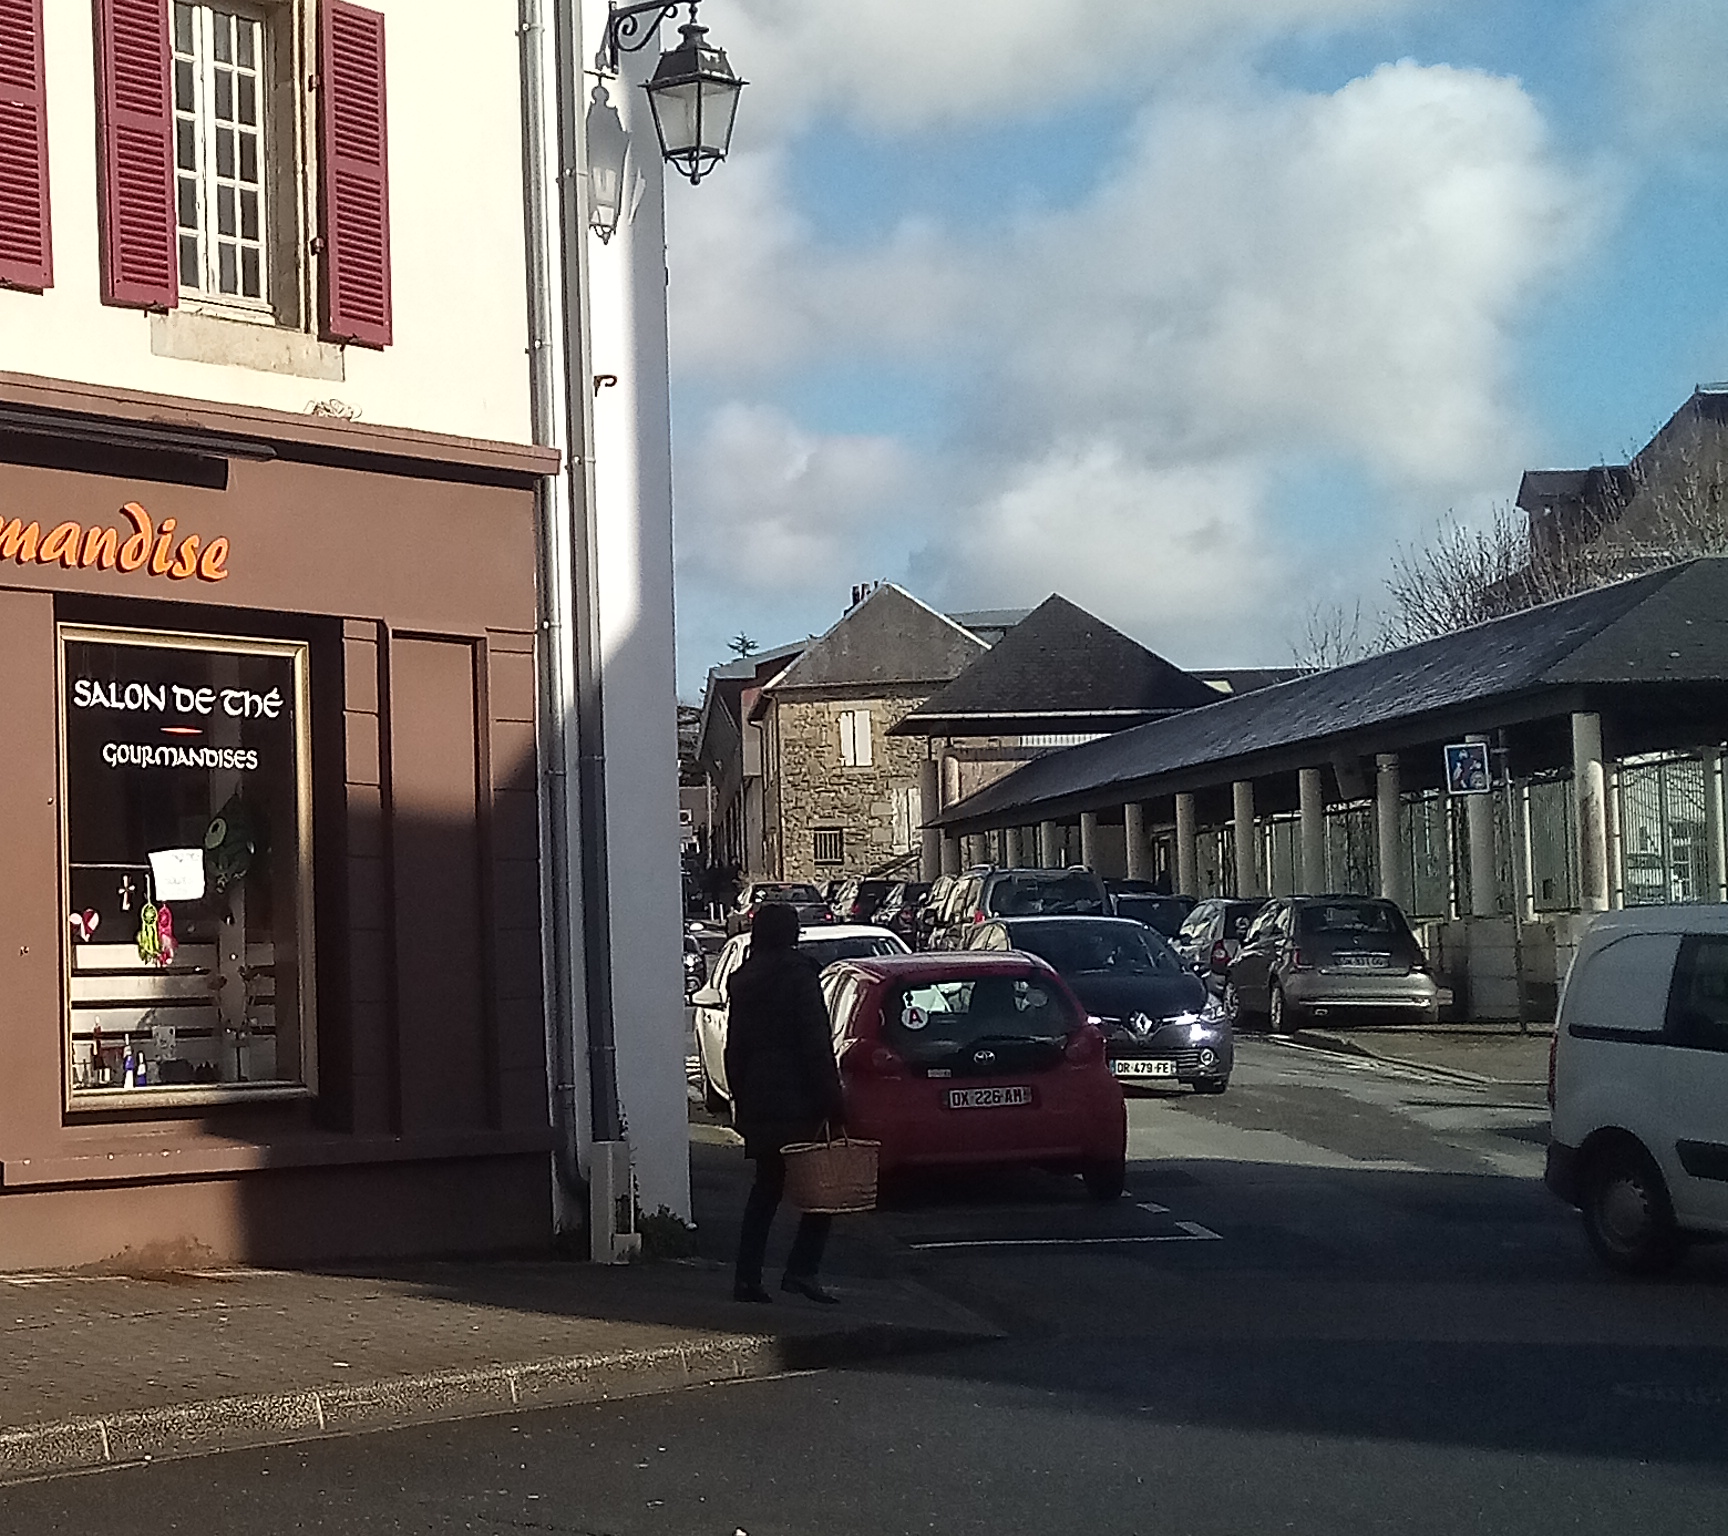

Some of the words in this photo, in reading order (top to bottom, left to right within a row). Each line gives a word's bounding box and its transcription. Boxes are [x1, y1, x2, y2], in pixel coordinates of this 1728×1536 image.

[73, 679, 167, 713] SALON
[172, 684, 217, 715] DE
[101, 742, 259, 770] GOURMANDISES
[908, 1008, 923, 1025] A
